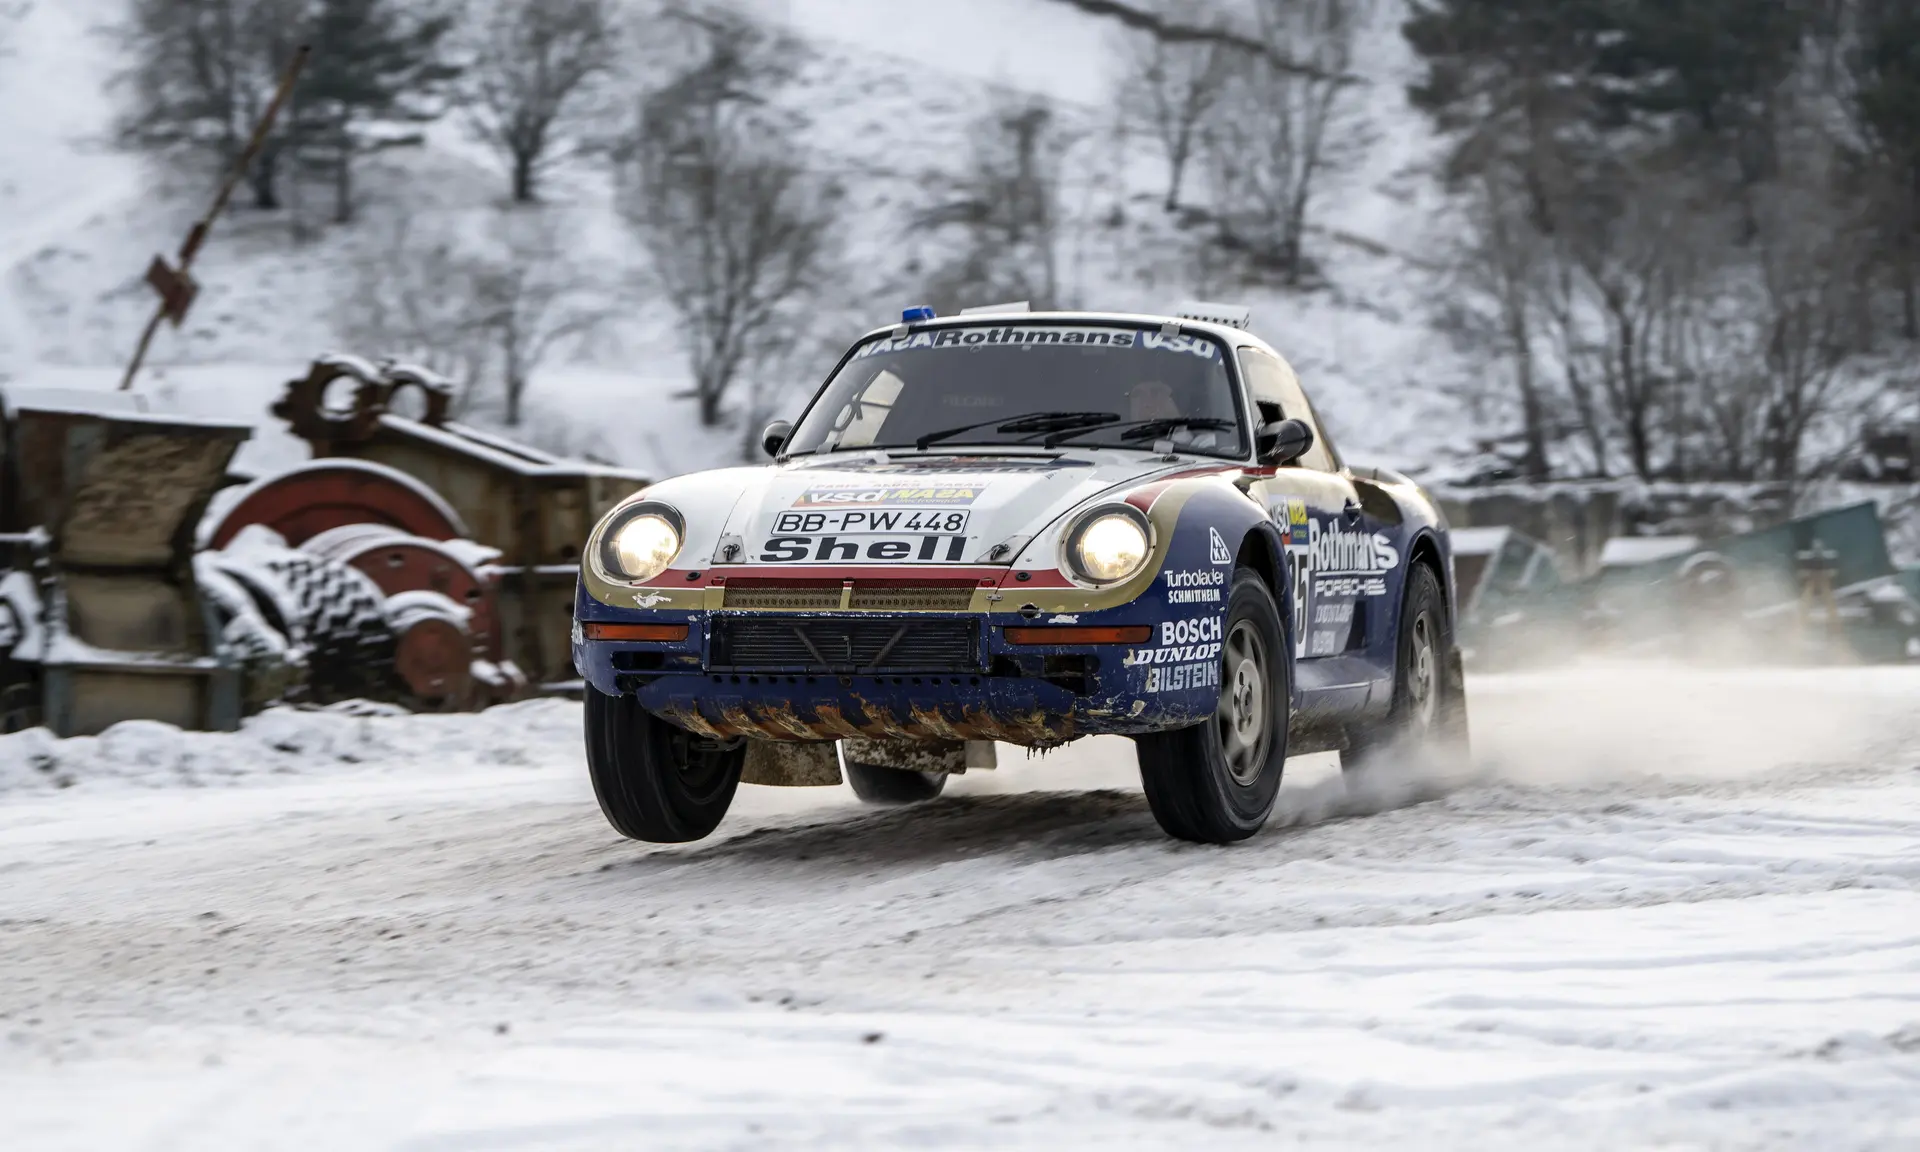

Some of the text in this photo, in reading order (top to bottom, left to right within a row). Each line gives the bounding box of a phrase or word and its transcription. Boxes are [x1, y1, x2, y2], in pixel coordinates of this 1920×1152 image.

[934, 327, 1134, 348] Rothmans
[777, 512, 964, 532] BB-PW 448
[759, 536, 968, 562] Shell
[1308, 518, 1400, 571] Rothmans
[1164, 568, 1224, 588] Turbolader
[1315, 578, 1387, 597] PORSCHE
[1162, 616, 1222, 646] BOSCH
[1133, 643, 1222, 665] DUNLOP
[1147, 661, 1218, 693] BILSTEIN
